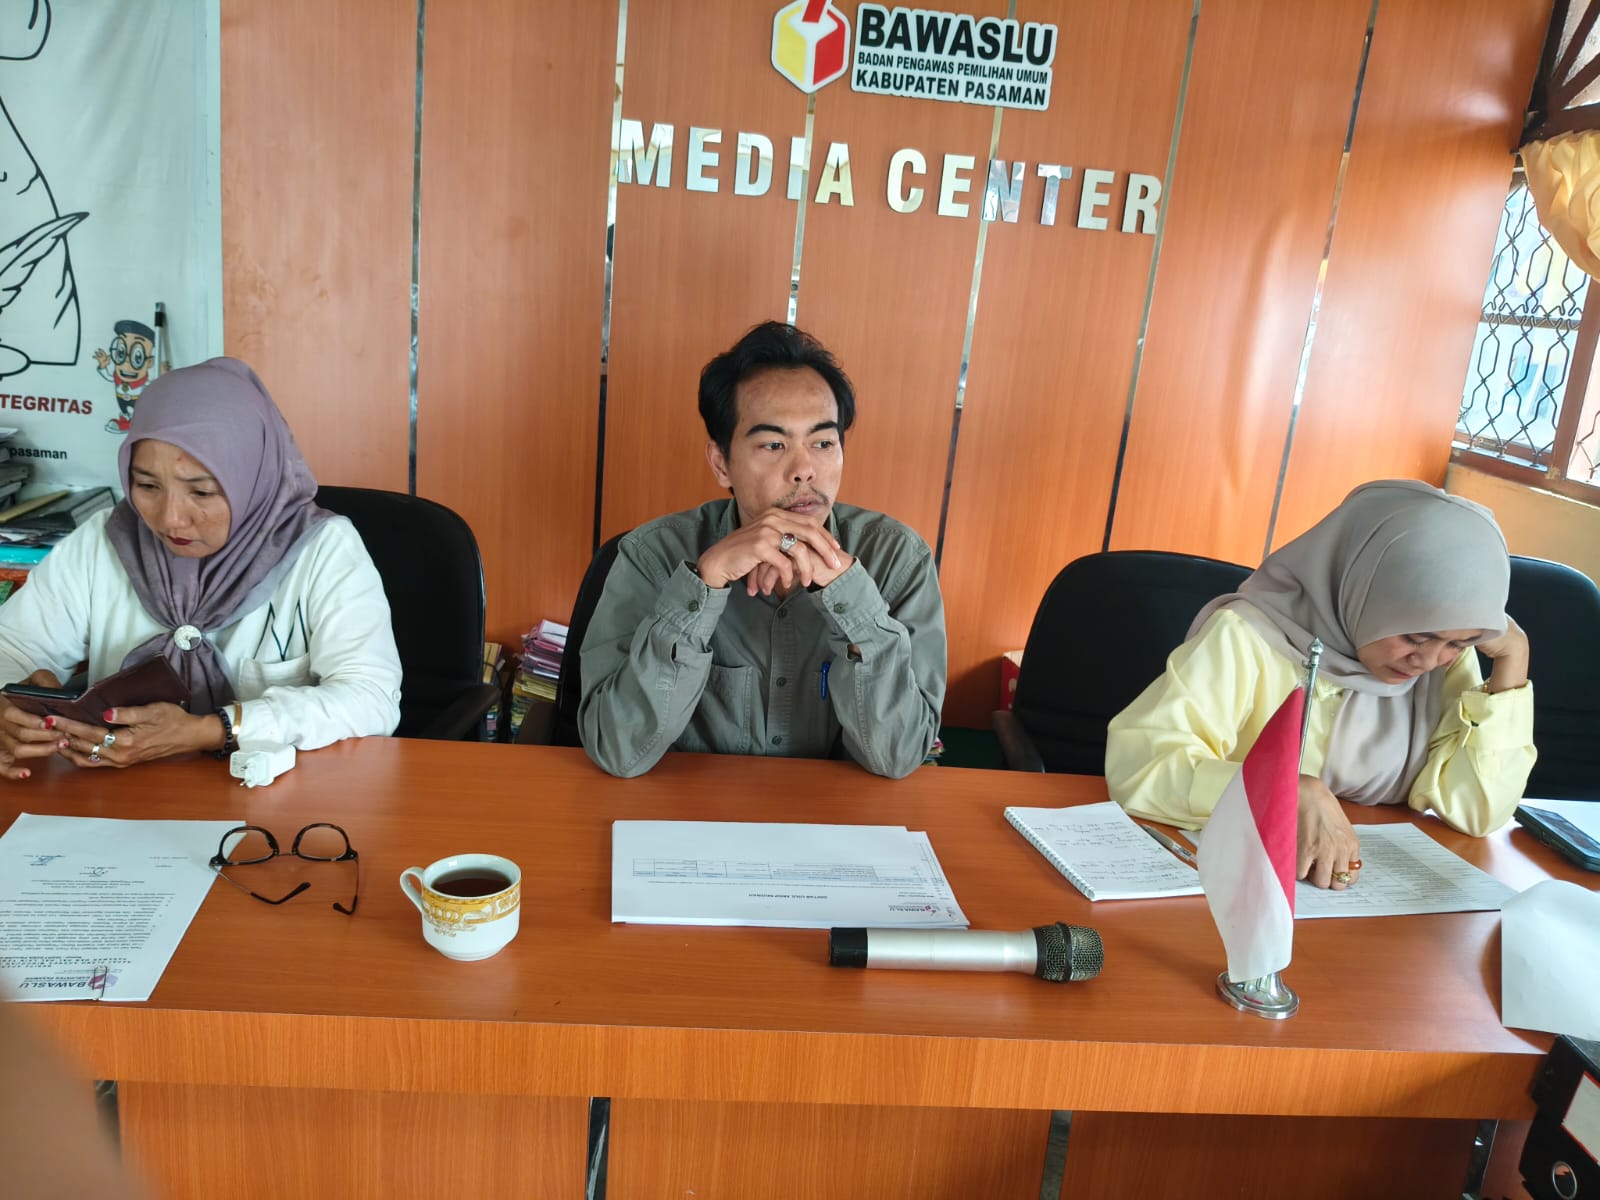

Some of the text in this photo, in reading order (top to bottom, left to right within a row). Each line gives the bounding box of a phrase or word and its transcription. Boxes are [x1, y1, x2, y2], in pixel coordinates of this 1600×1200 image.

[859, 8, 1054, 66] BAWASLU
[858, 51, 1048, 84] BADAN PENGAWAS PEMILIHAN UMUM
[856, 69, 1046, 106] KABUPATEN PASAMAN
[617, 118, 1163, 235] MEDIA CENTER
[0, 393, 93, 415] TEGRITAS
[19, 980, 87, 989] BAWASLU
